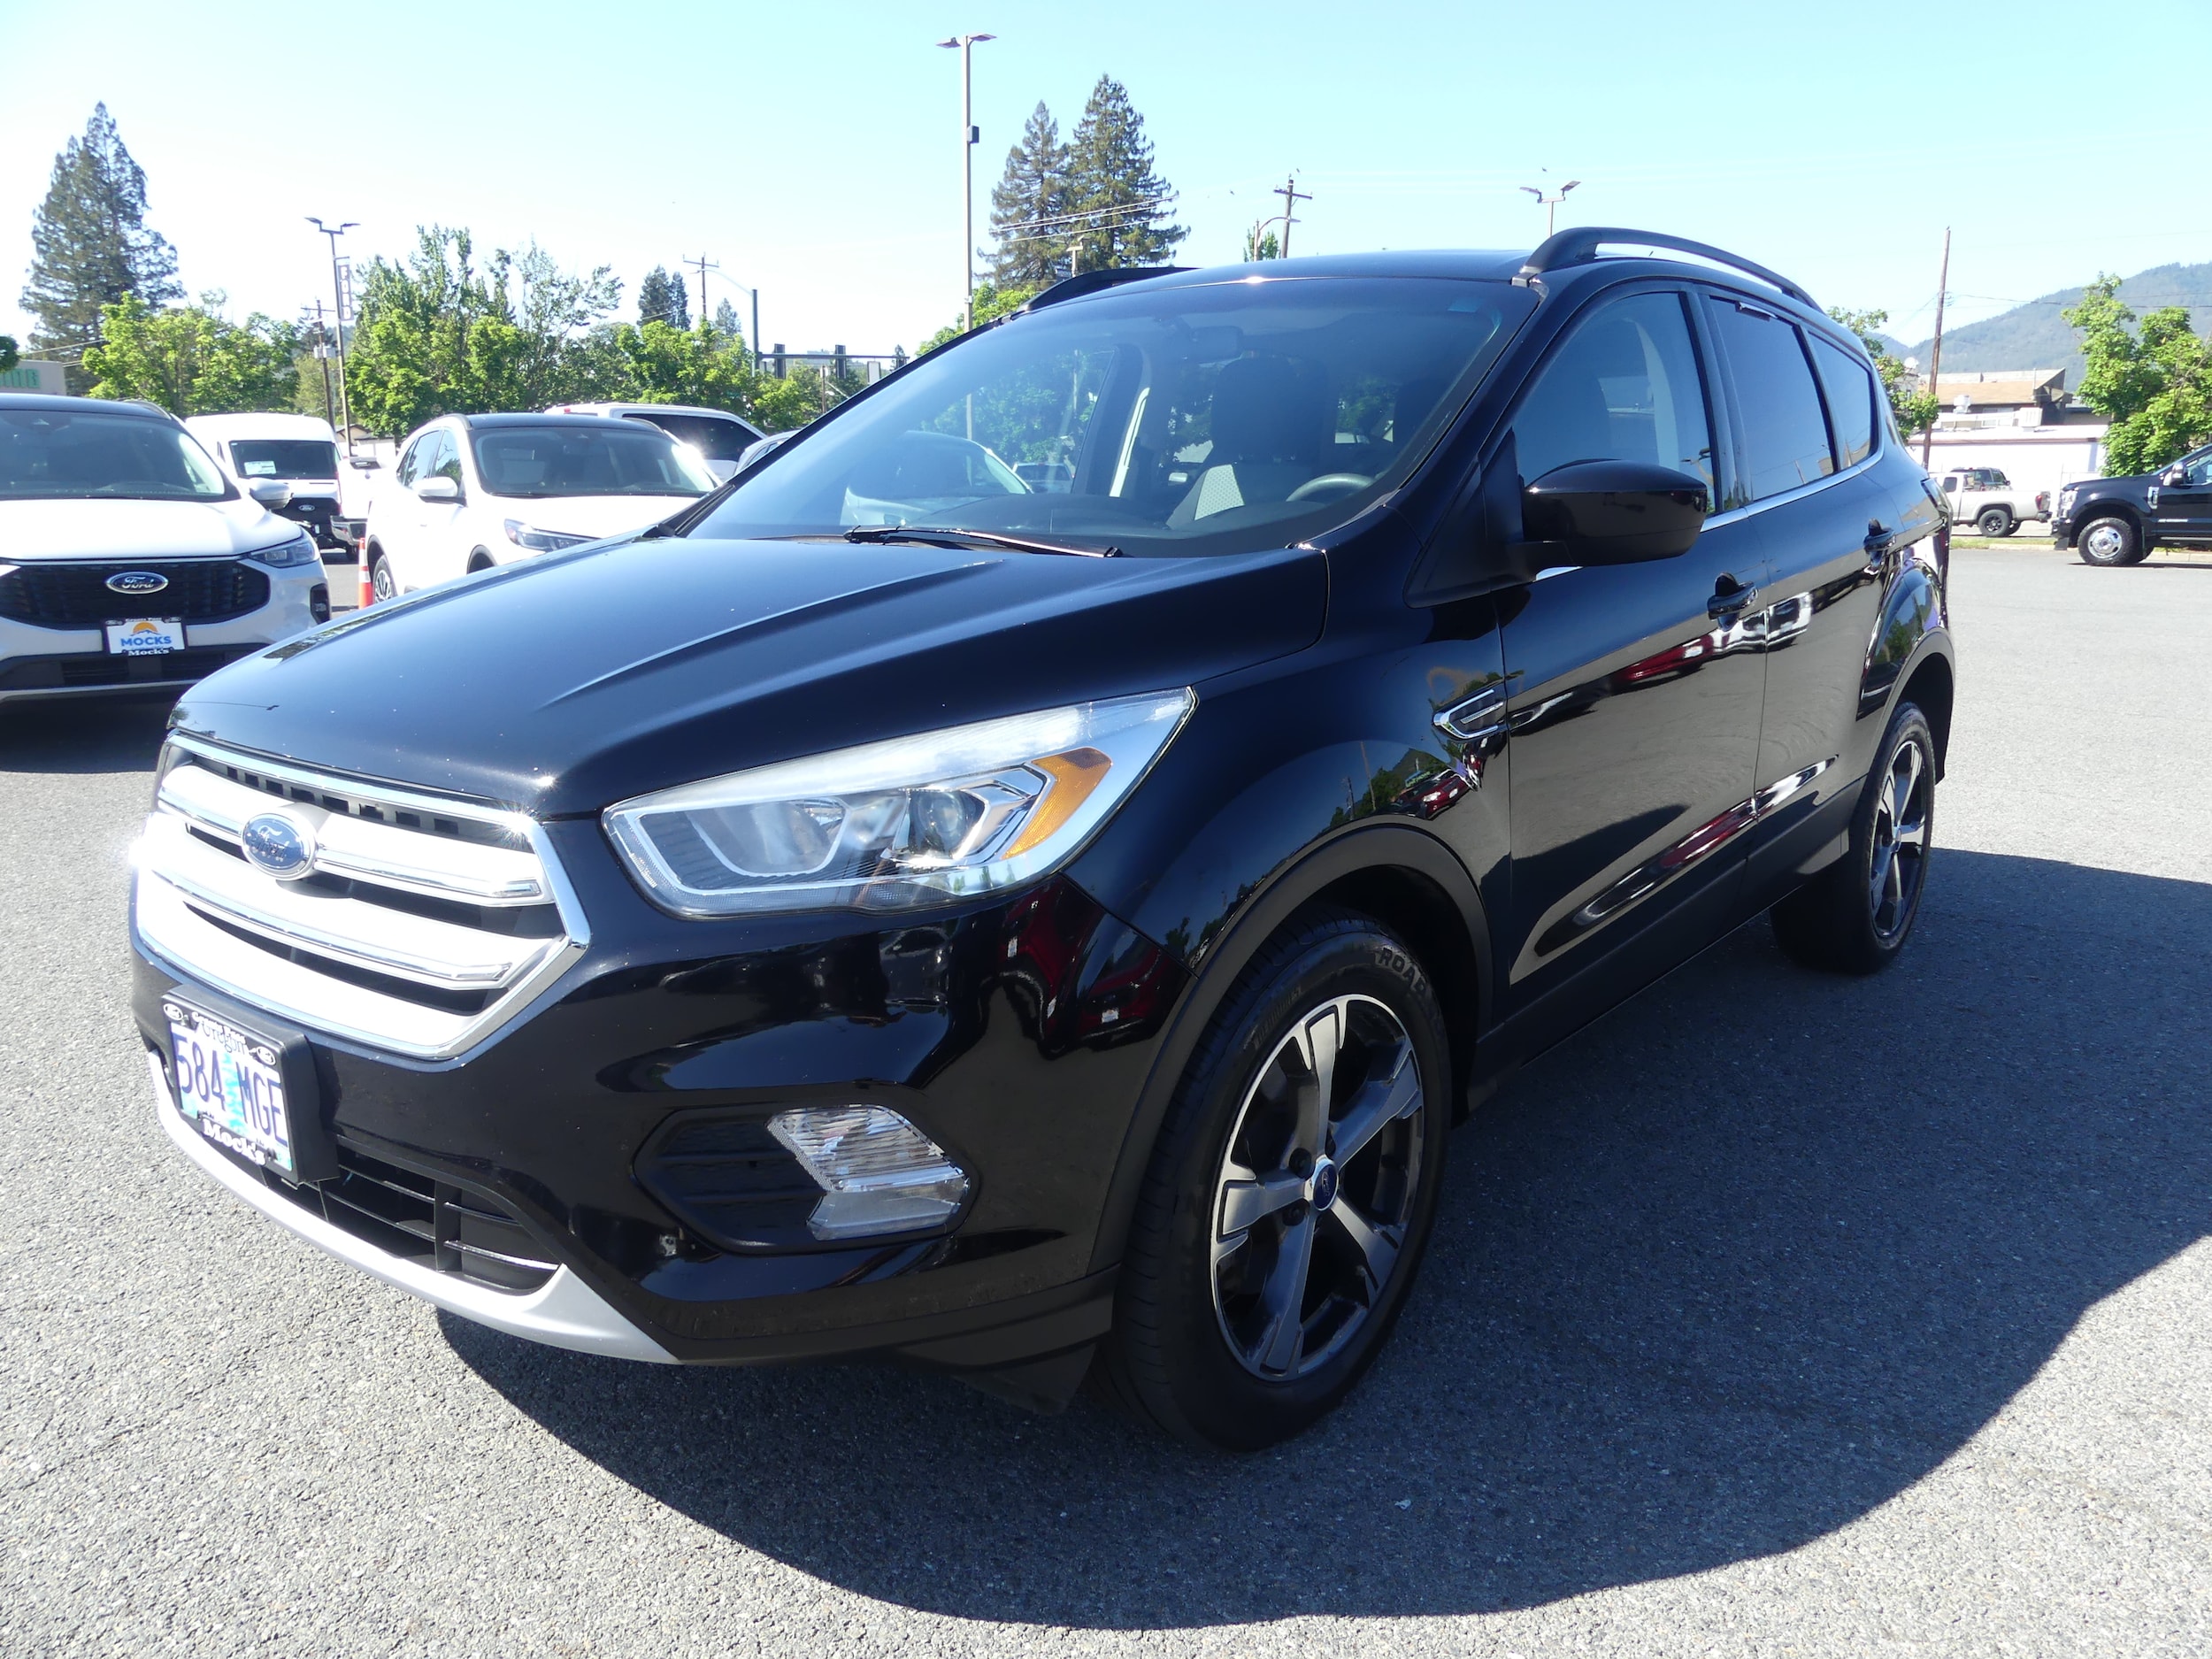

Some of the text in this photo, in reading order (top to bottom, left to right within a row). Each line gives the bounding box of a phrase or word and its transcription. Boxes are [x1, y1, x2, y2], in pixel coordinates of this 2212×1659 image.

[121, 576, 154, 589] Ford
[120, 635, 172, 646] MOCKS
[173, 1032, 288, 1148] 584 MGE
